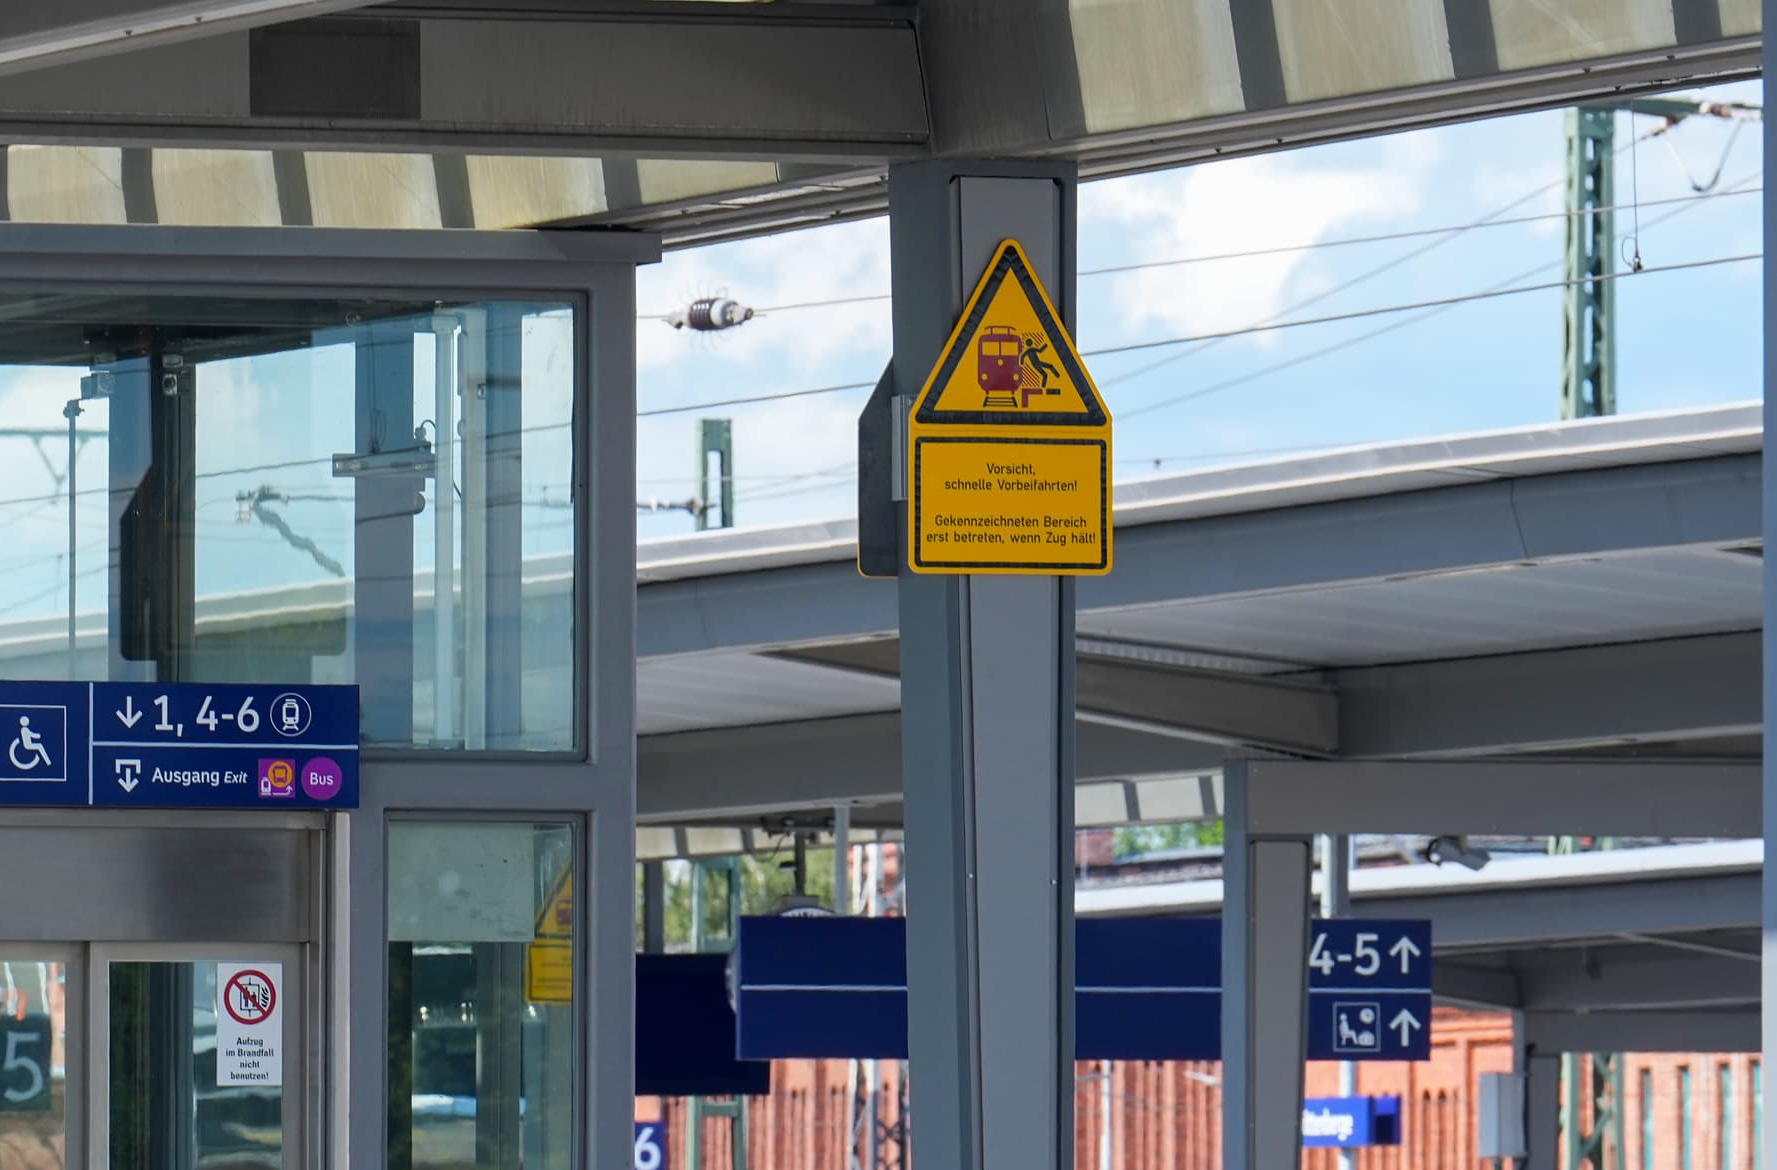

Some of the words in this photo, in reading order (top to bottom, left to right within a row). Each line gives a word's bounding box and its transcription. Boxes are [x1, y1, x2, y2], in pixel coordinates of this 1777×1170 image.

[986, 463, 1036, 476] Vorsicht,
[944, 480, 992, 491] schnelle
[998, 480, 1078, 492] Vorbeifahrten!
[934, 515, 1039, 528] Gekennzeichneten
[1044, 516, 1087, 528] Bereich
[926, 532, 949, 543] erst
[953, 532, 1005, 545] betreten,
[1010, 534, 1041, 544] wenn
[1045, 532, 1067, 546] Zug
[1071, 532, 1096, 545] hält!
[153, 695, 183, 737] 1,
[196, 695, 260, 733] 4-6
[152, 767, 220, 787] Ausgang
[223, 771, 248, 784] Exit
[309, 772, 334, 786] Bus
[1308, 933, 1380, 976] 4-5
[236, 1037, 264, 1047] Aufzug
[225, 1049, 236, 1057] im
[237, 1048, 274, 1057] Brandfall
[2, 1031, 44, 1102] 5
[239, 1060, 260, 1069] nicht
[230, 1071, 269, 1080] benutzen!
